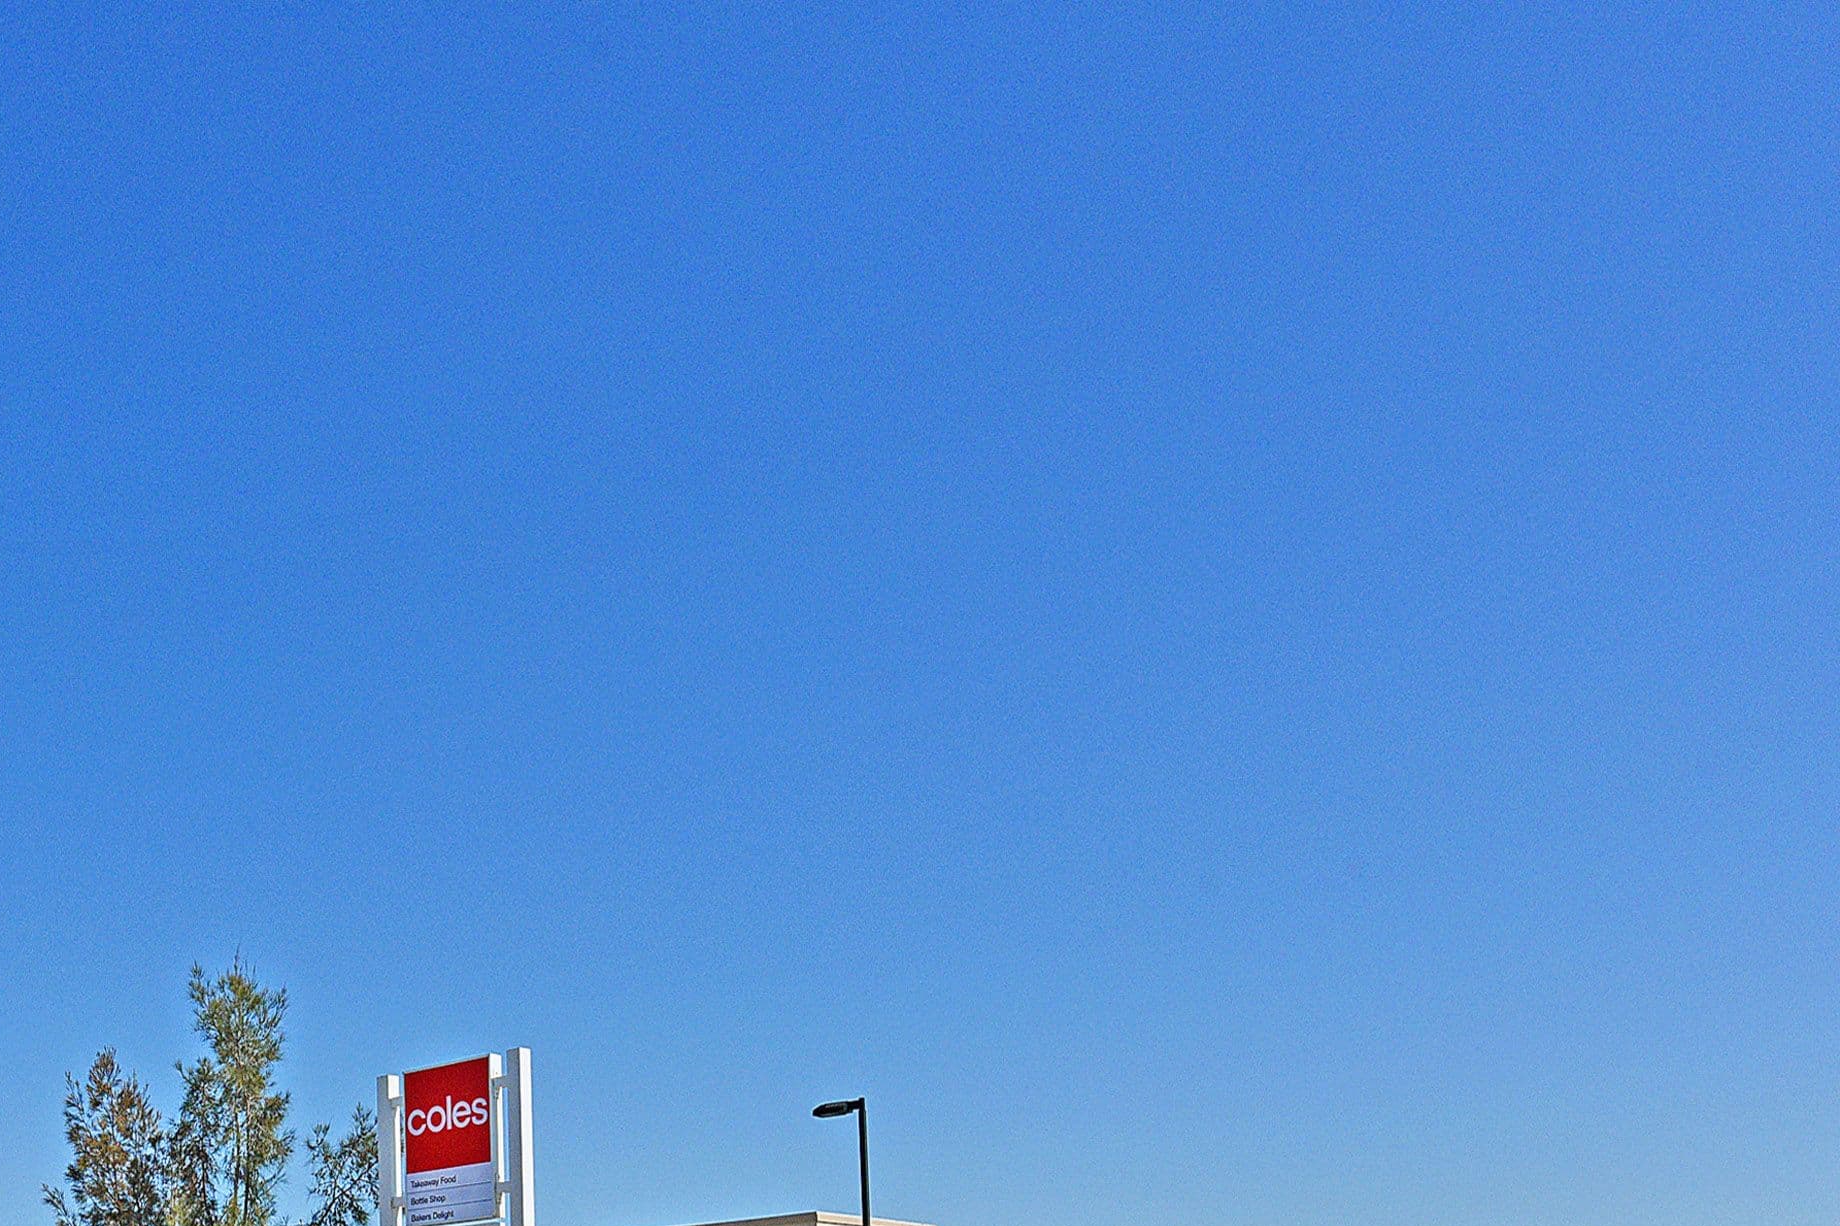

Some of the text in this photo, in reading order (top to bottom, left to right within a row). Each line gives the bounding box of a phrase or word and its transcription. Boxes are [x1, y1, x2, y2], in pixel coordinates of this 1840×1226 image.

[407, 1095, 489, 1136] coles
[411, 1176, 456, 1188] Takeaway Food
[411, 1194, 446, 1205] Bottle Shop
[411, 1210, 454, 1223] Bakers Delight
